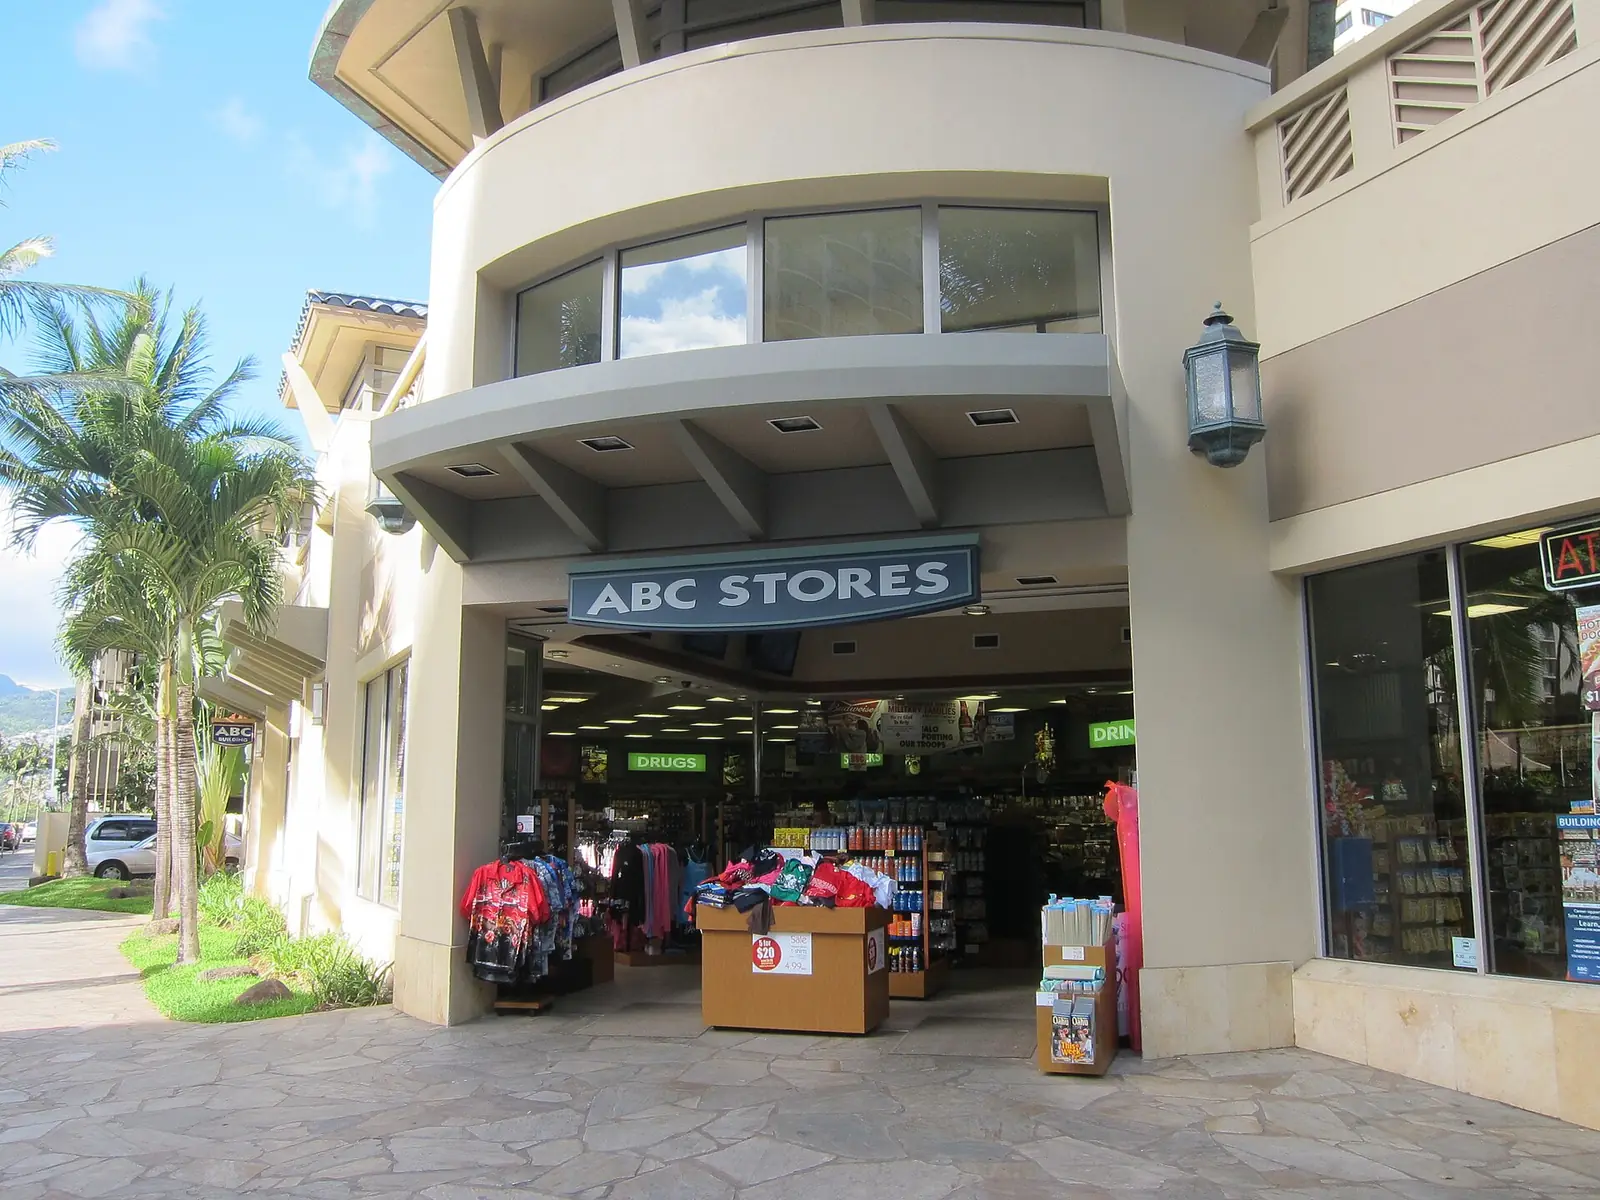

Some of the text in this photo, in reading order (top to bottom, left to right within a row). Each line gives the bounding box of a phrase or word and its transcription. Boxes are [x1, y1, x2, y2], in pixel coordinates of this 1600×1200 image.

[586, 561, 950, 616] ABC STORES
[215, 727, 251, 737] ABC
[899, 739, 946, 749] OUR TROOPS
[637, 756, 697, 768] DRUGS
[790, 934, 808, 944] Sale
[756, 946, 775, 960] $20
